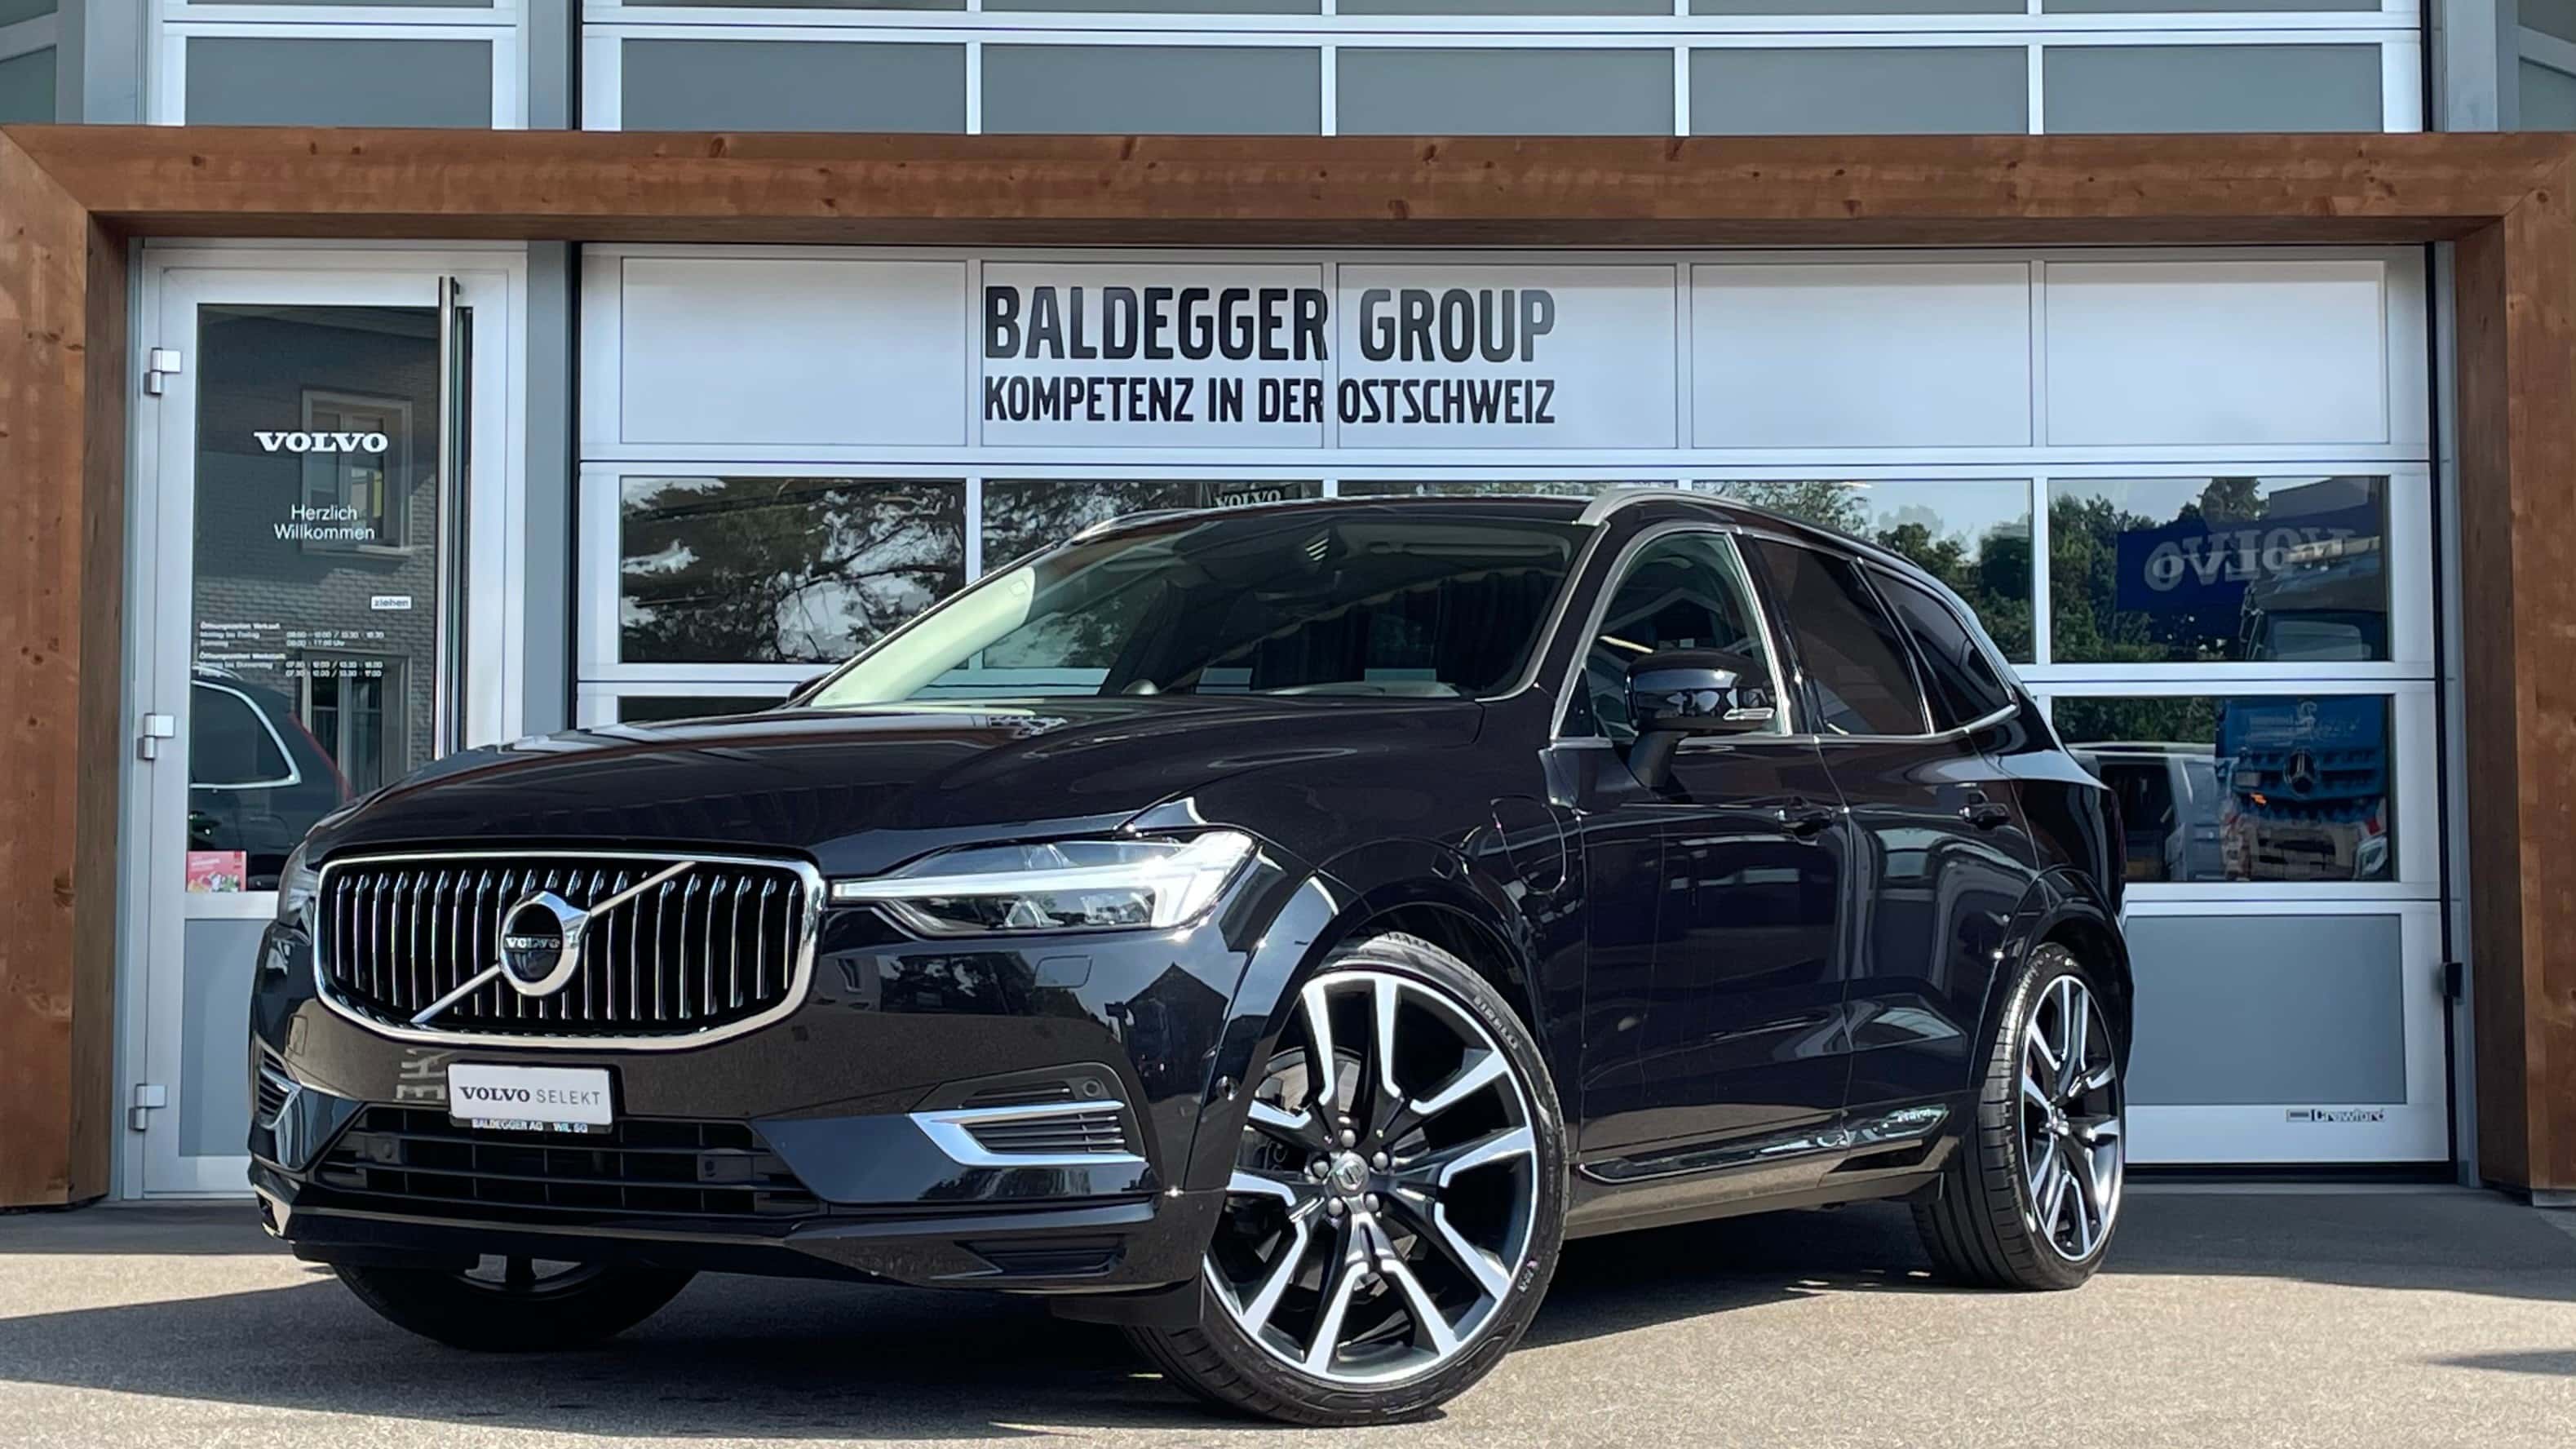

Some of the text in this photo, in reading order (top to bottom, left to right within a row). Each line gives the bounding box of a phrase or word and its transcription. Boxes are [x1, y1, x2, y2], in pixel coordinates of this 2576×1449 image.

[984, 286, 1556, 362] BALDEGGER GROUP
[984, 376, 1556, 423] KOMPETENZ IN DER OSTSCHWEIZ
[254, 432, 388, 452] VOLVO
[1215, 490, 1281, 507] VOLVO
[290, 503, 358, 521] Herzlich
[274, 523, 375, 540] Willkommen
[506, 937, 561, 948] VOLVO
[458, 1086, 600, 1105] VOLVO SELEKT
[2316, 1108, 2388, 1123] Crawford
[471, 1118, 527, 1131] BALDEGGER
[529, 1121, 544, 1132] AG
